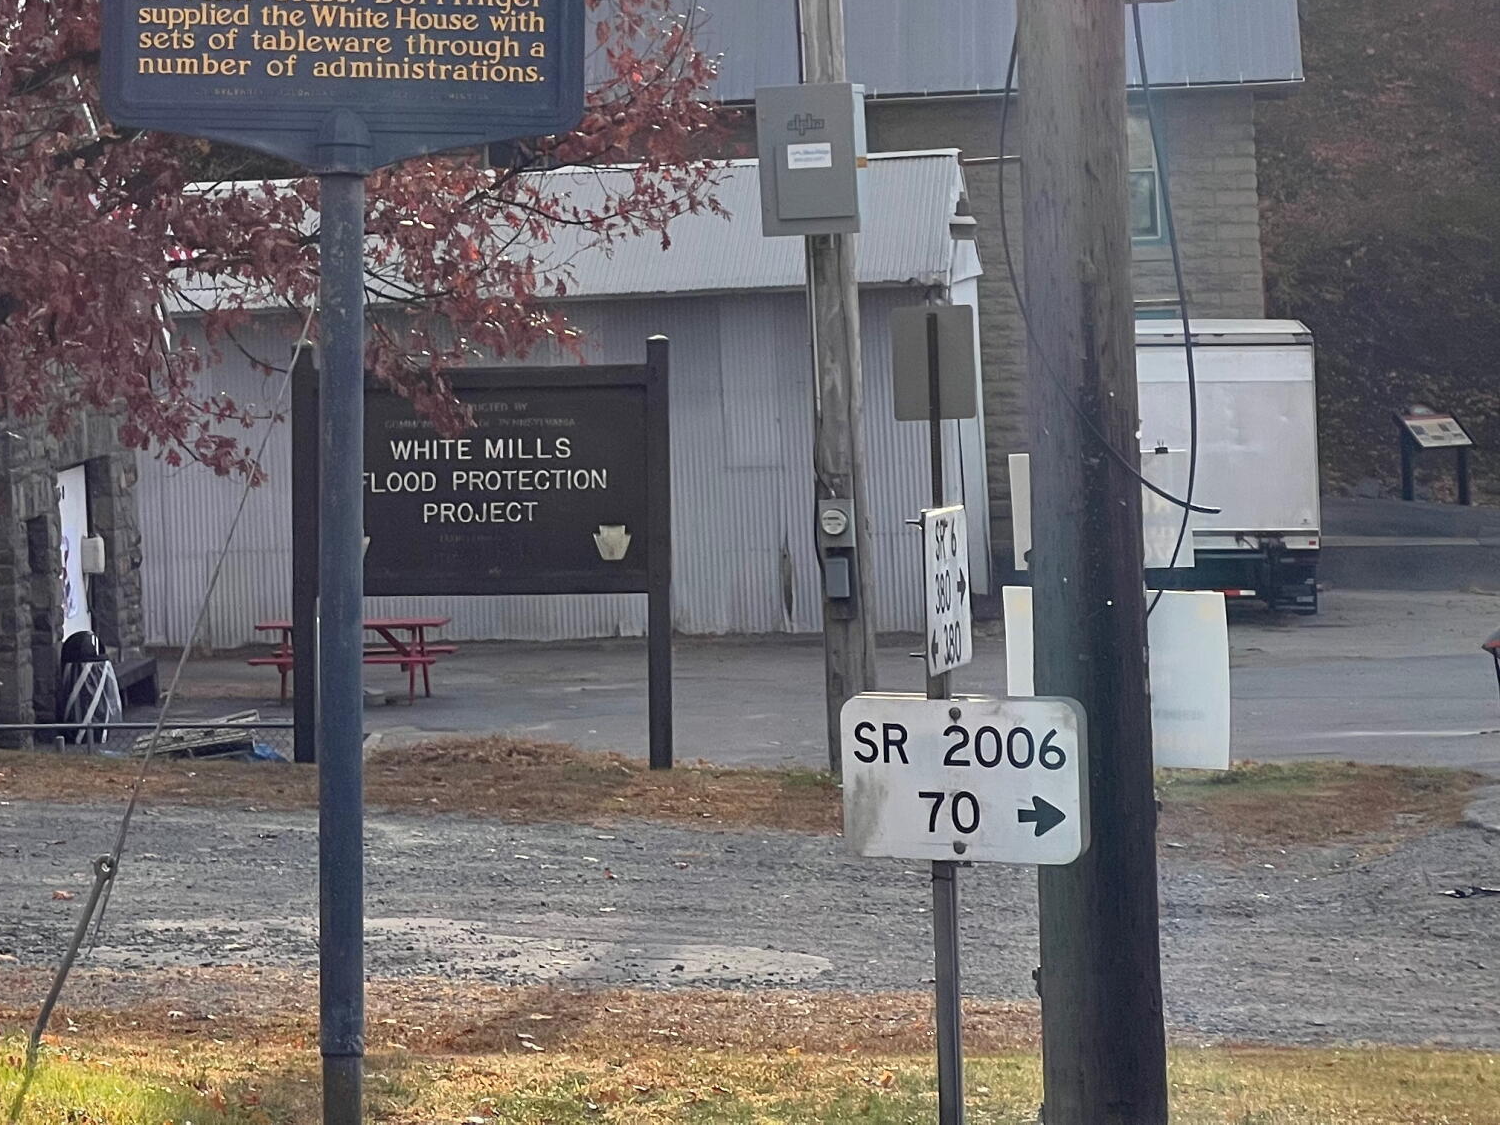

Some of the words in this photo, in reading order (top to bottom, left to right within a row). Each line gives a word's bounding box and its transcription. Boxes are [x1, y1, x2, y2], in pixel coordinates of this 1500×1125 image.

[139, 4, 249, 28] supplied
[262, 5, 305, 27] the
[311, 5, 389, 29] White
[396, 8, 478, 30] House
[489, 11, 545, 32] with
[139, 30, 195, 49] sets
[208, 29, 238, 49] of
[252, 30, 391, 53] tableware
[405, 34, 520, 60] through
[530, 41, 545, 57] a
[139, 54, 251, 75] number
[267, 55, 296, 76] of
[313, 57, 545, 82] administrations.
[391, 439, 472, 460] WHITE
[485, 438, 571, 458] MILLS
[453, 469, 607, 490] PROTECTION
[423, 502, 538, 523] PROJECT
[935, 520, 946, 559] SR
[951, 521, 957, 556] 6
[936, 573, 951, 613] 380
[944, 621, 961, 665] 380
[853, 722, 908, 764] SR
[943, 726, 1066, 770] 2006
[918, 791, 980, 833] 70
